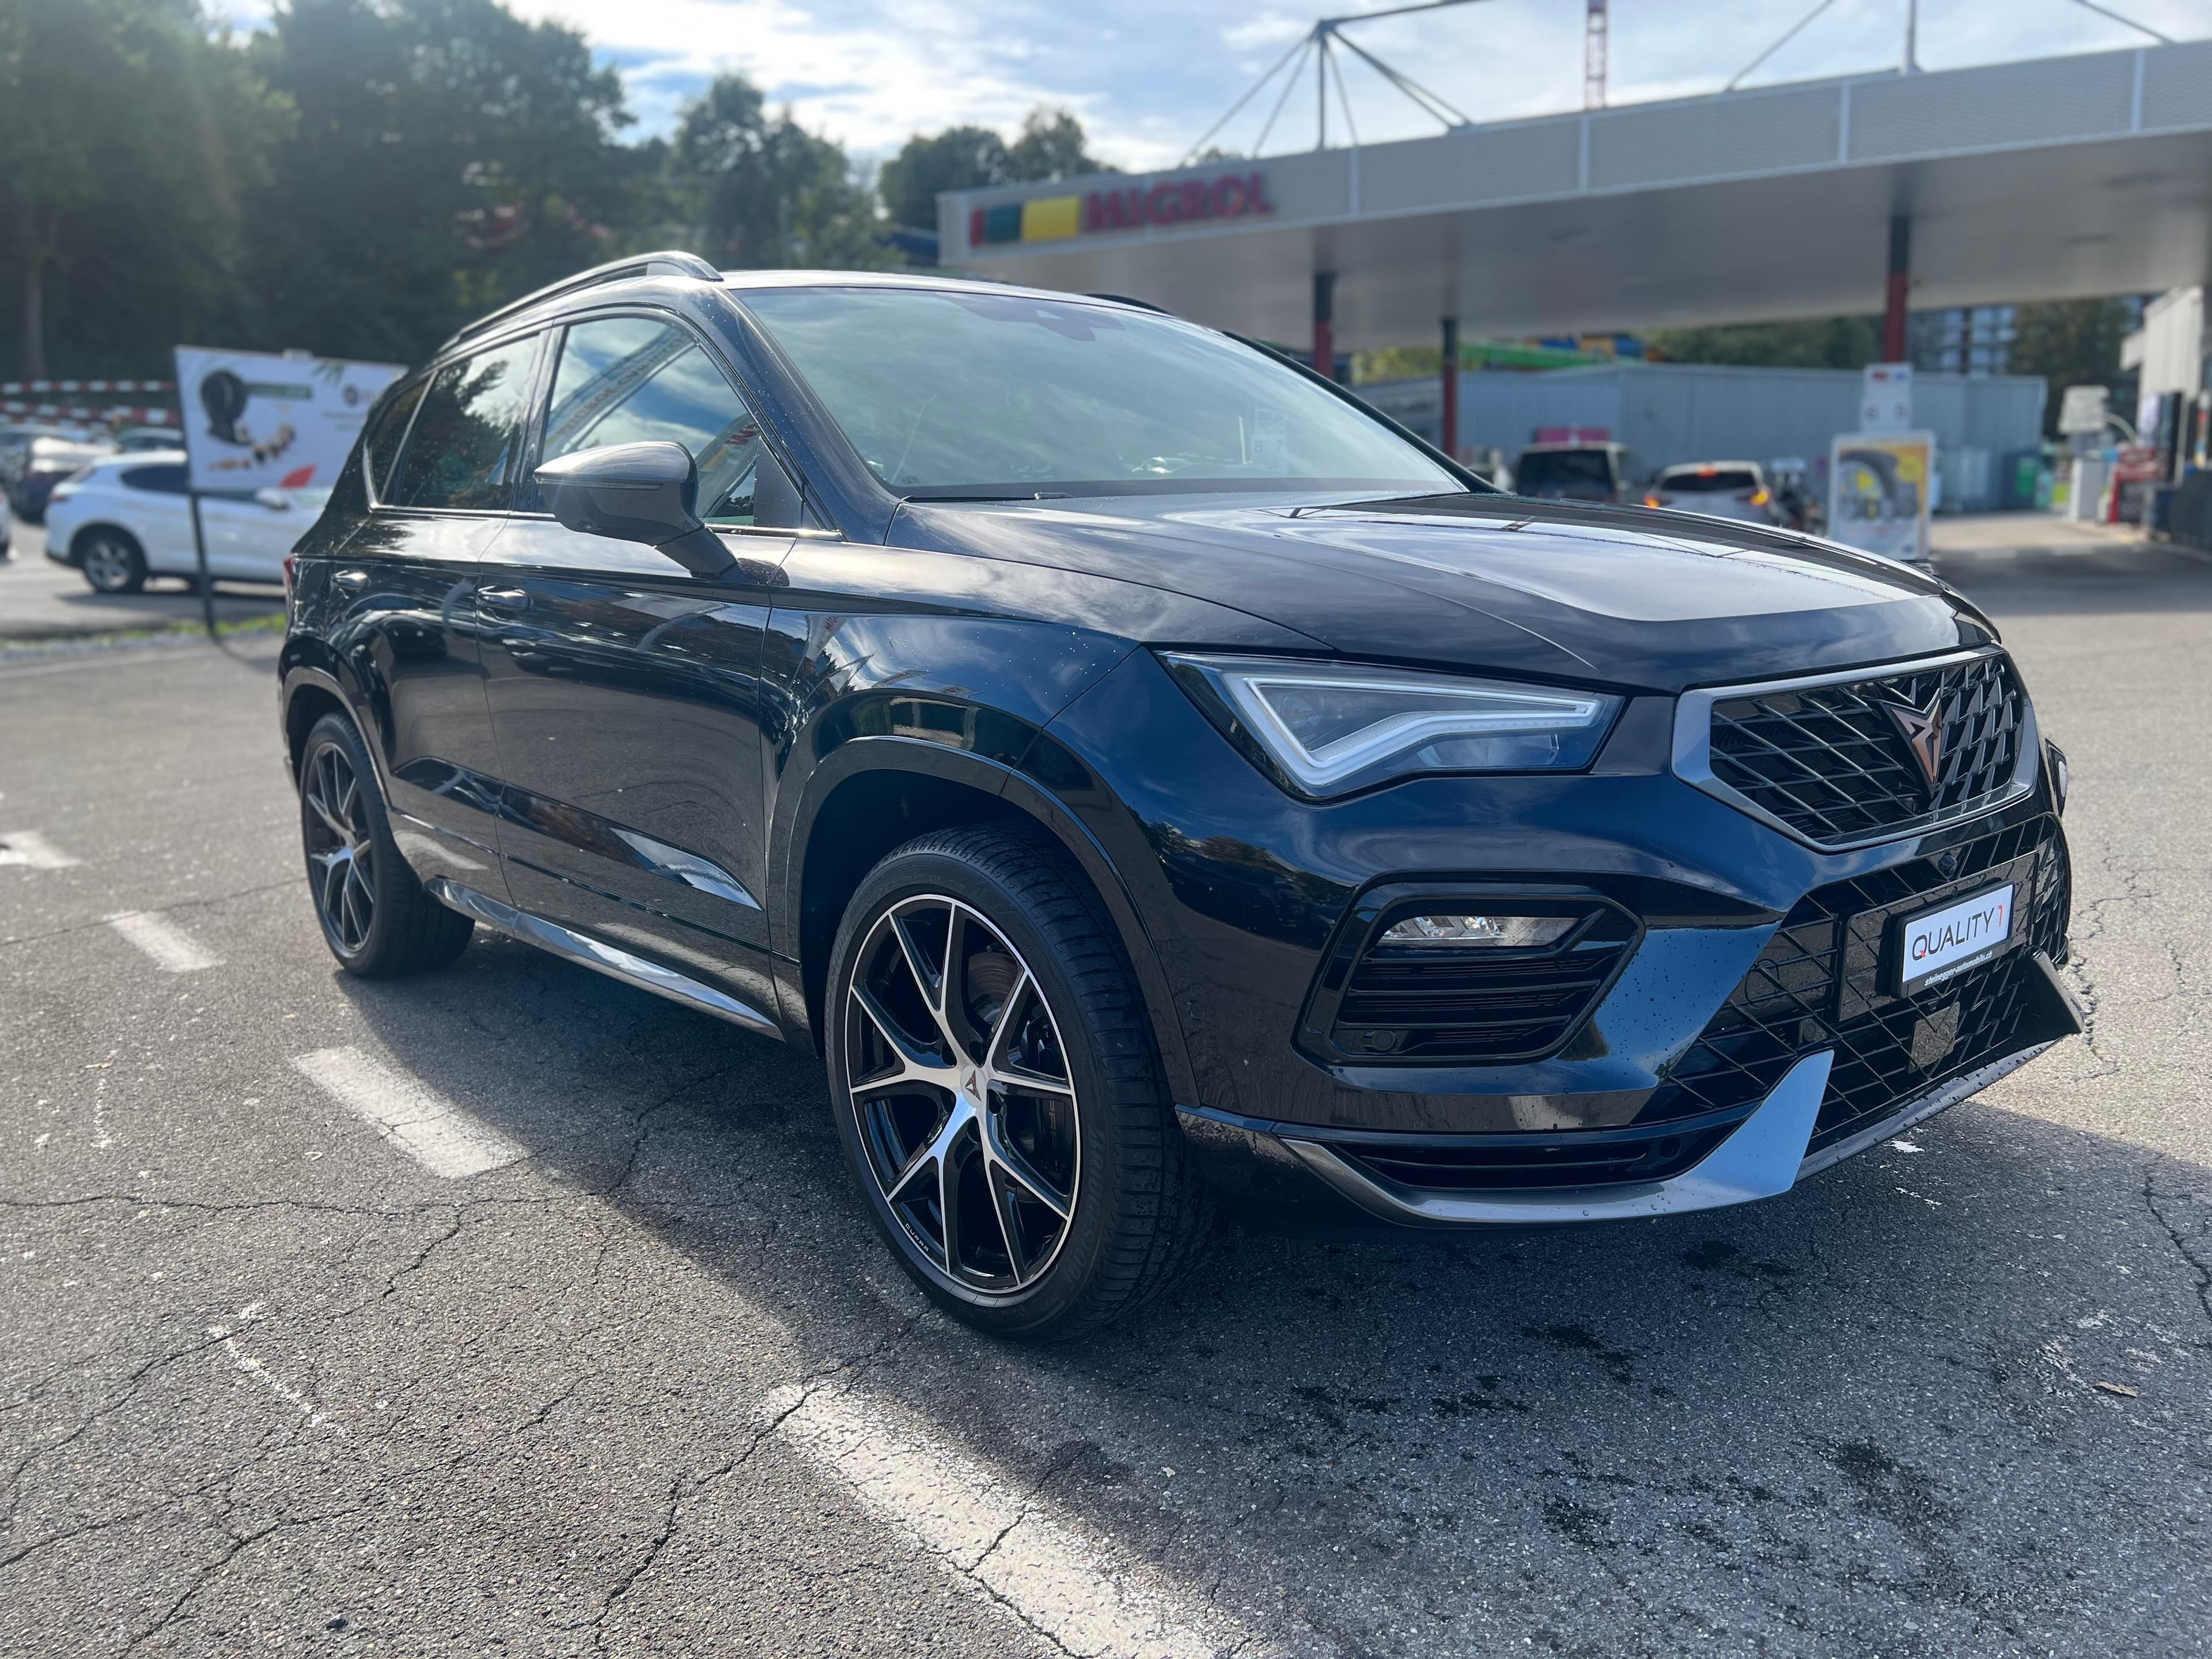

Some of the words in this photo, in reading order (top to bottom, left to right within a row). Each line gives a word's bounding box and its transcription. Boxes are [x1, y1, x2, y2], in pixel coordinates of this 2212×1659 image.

[1086, 172, 1273, 232] MIGROL
[1924, 951, 1993, 987] steinegger-automobile.ch
[1048, 1100, 1057, 1148] PRA
[1063, 1124, 1105, 1293] BRIDGESTONE
[905, 1222, 929, 1252] CUPRA
